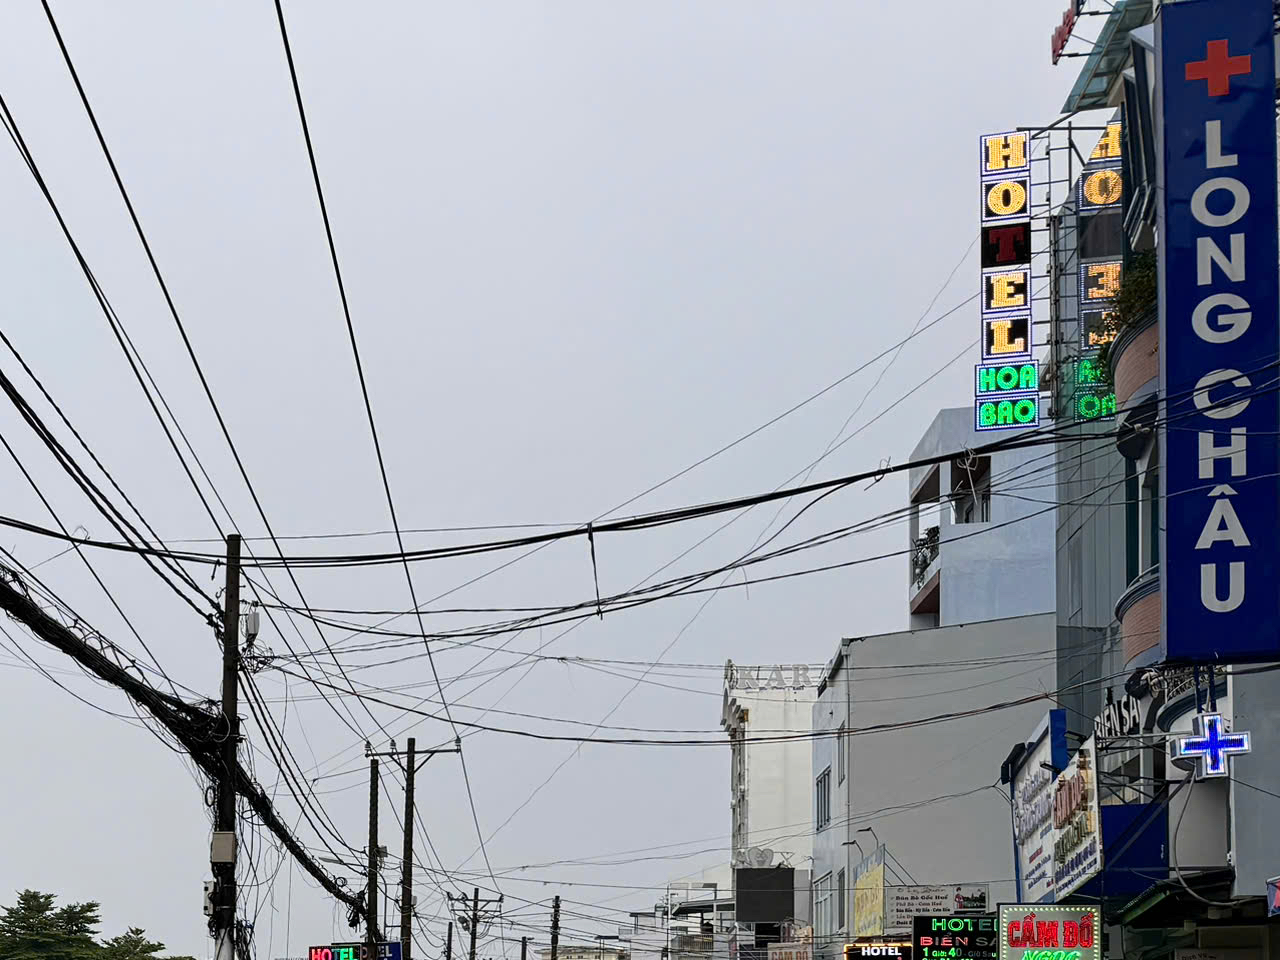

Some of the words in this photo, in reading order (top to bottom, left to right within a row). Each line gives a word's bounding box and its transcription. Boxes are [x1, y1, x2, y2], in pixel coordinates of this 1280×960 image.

[985, 134, 1027, 355] HOTEL
[1191, 119, 1253, 344] LONG
[980, 364, 1035, 392] HOA
[980, 399, 1035, 426] BAO
[1193, 368, 1252, 613] CHÂU
[861, 946, 902, 956] HOTEL
[920, 932, 969, 946] BIỂN
[948, 947, 963, 957] 40
